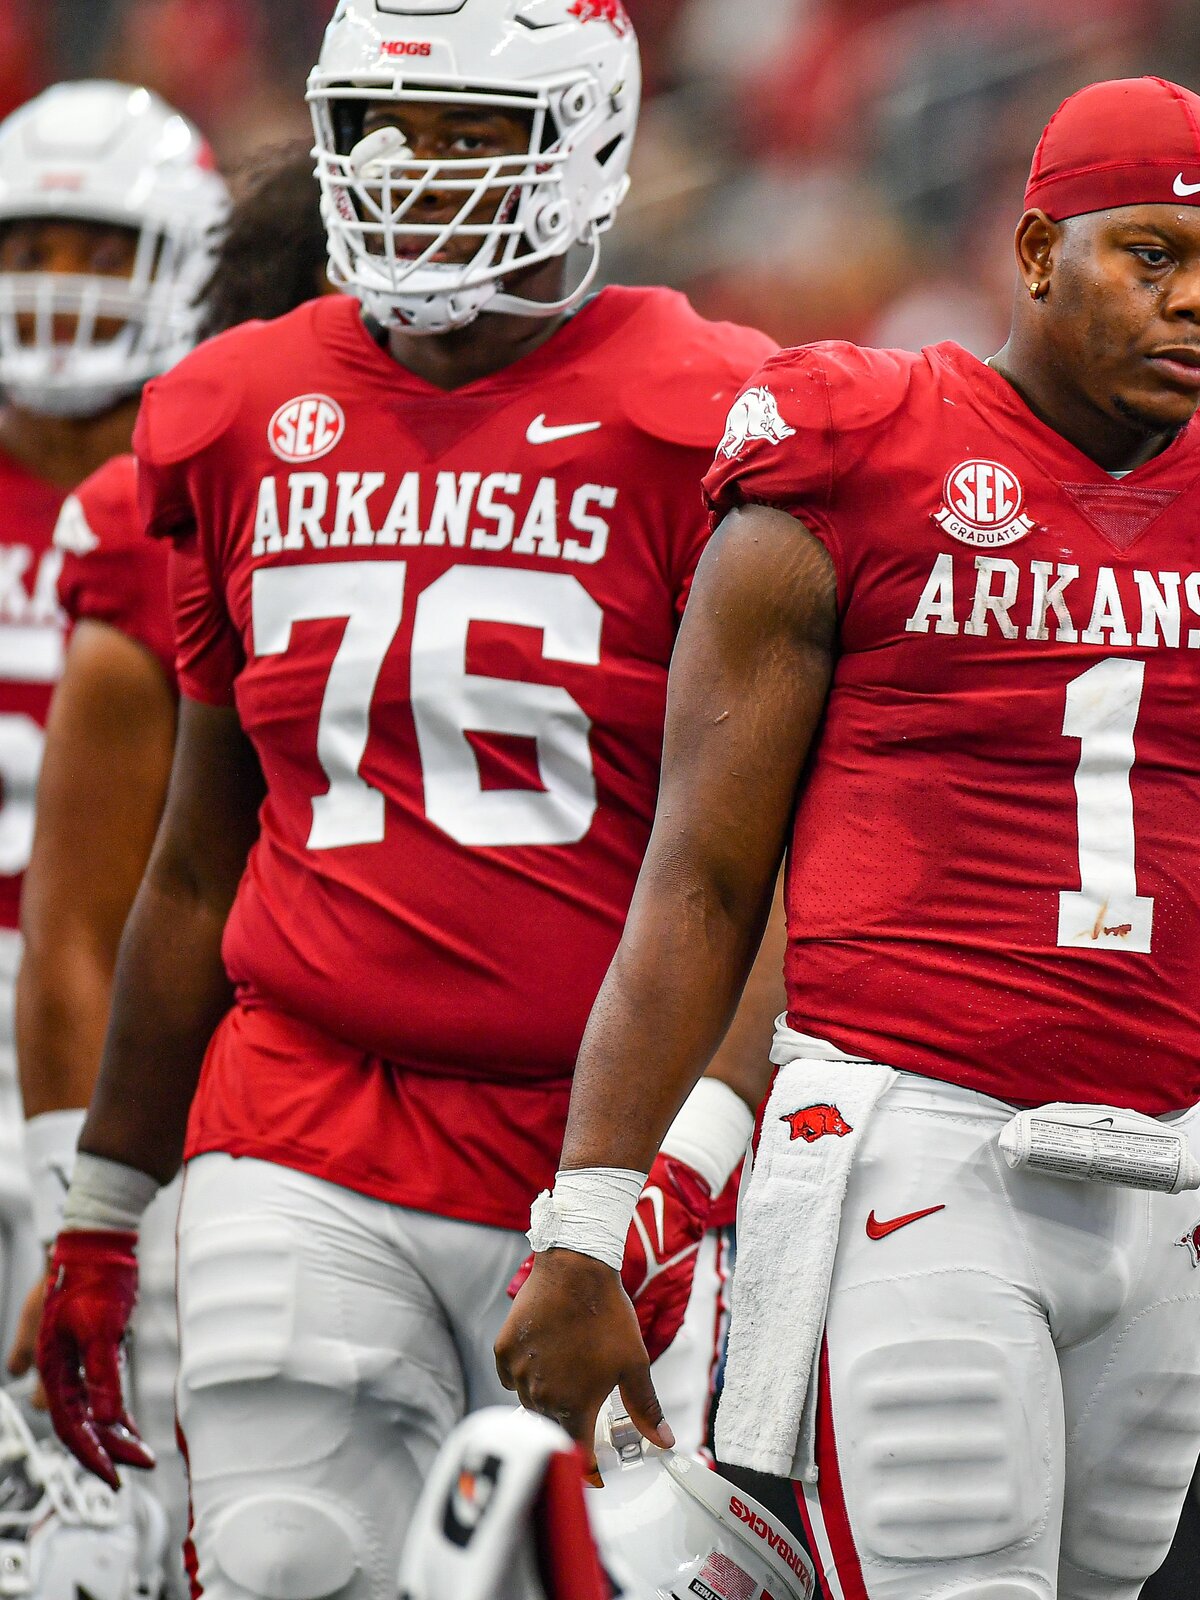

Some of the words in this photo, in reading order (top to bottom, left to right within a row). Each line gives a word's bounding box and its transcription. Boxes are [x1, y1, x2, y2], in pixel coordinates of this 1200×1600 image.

[381, 41, 431, 56] HOGS
[275, 399, 337, 456] SEC
[252, 472, 618, 564] ARKANSAS
[954, 464, 1014, 522] SEC
[949, 522, 1020, 543] GRADUATE
[252, 560, 604, 849] 76
[1057, 658, 1154, 953] 1
